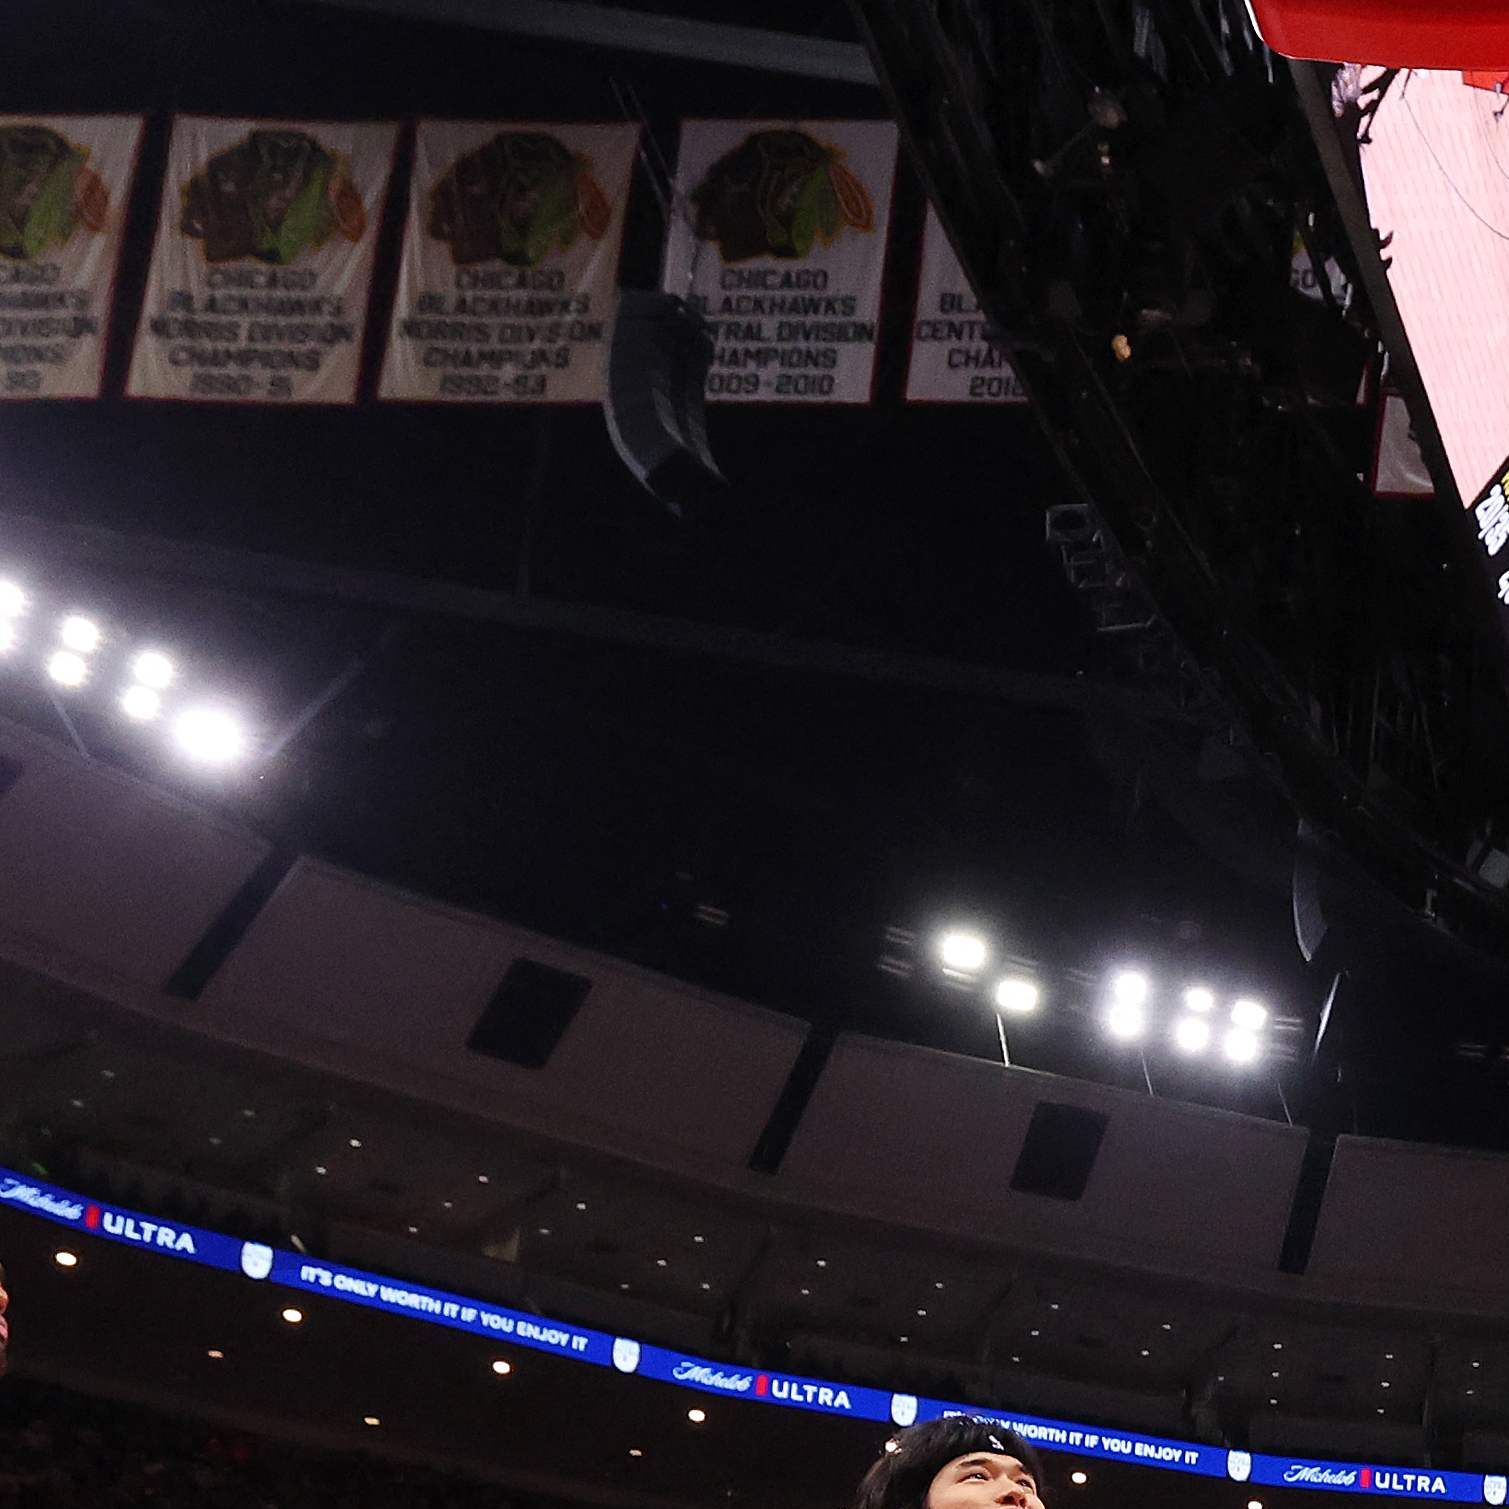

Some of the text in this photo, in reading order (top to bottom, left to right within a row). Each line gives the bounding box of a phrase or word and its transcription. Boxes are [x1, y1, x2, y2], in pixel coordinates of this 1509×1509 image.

[719, 269, 829, 291] CHICAGO
[776, 321, 875, 343] DIVISION
[103, 1211, 195, 1254] ULTRA
[672, 1361, 851, 1409] Michelob ULTRA
[1283, 1465, 1446, 1494] Michelob ULTRA
